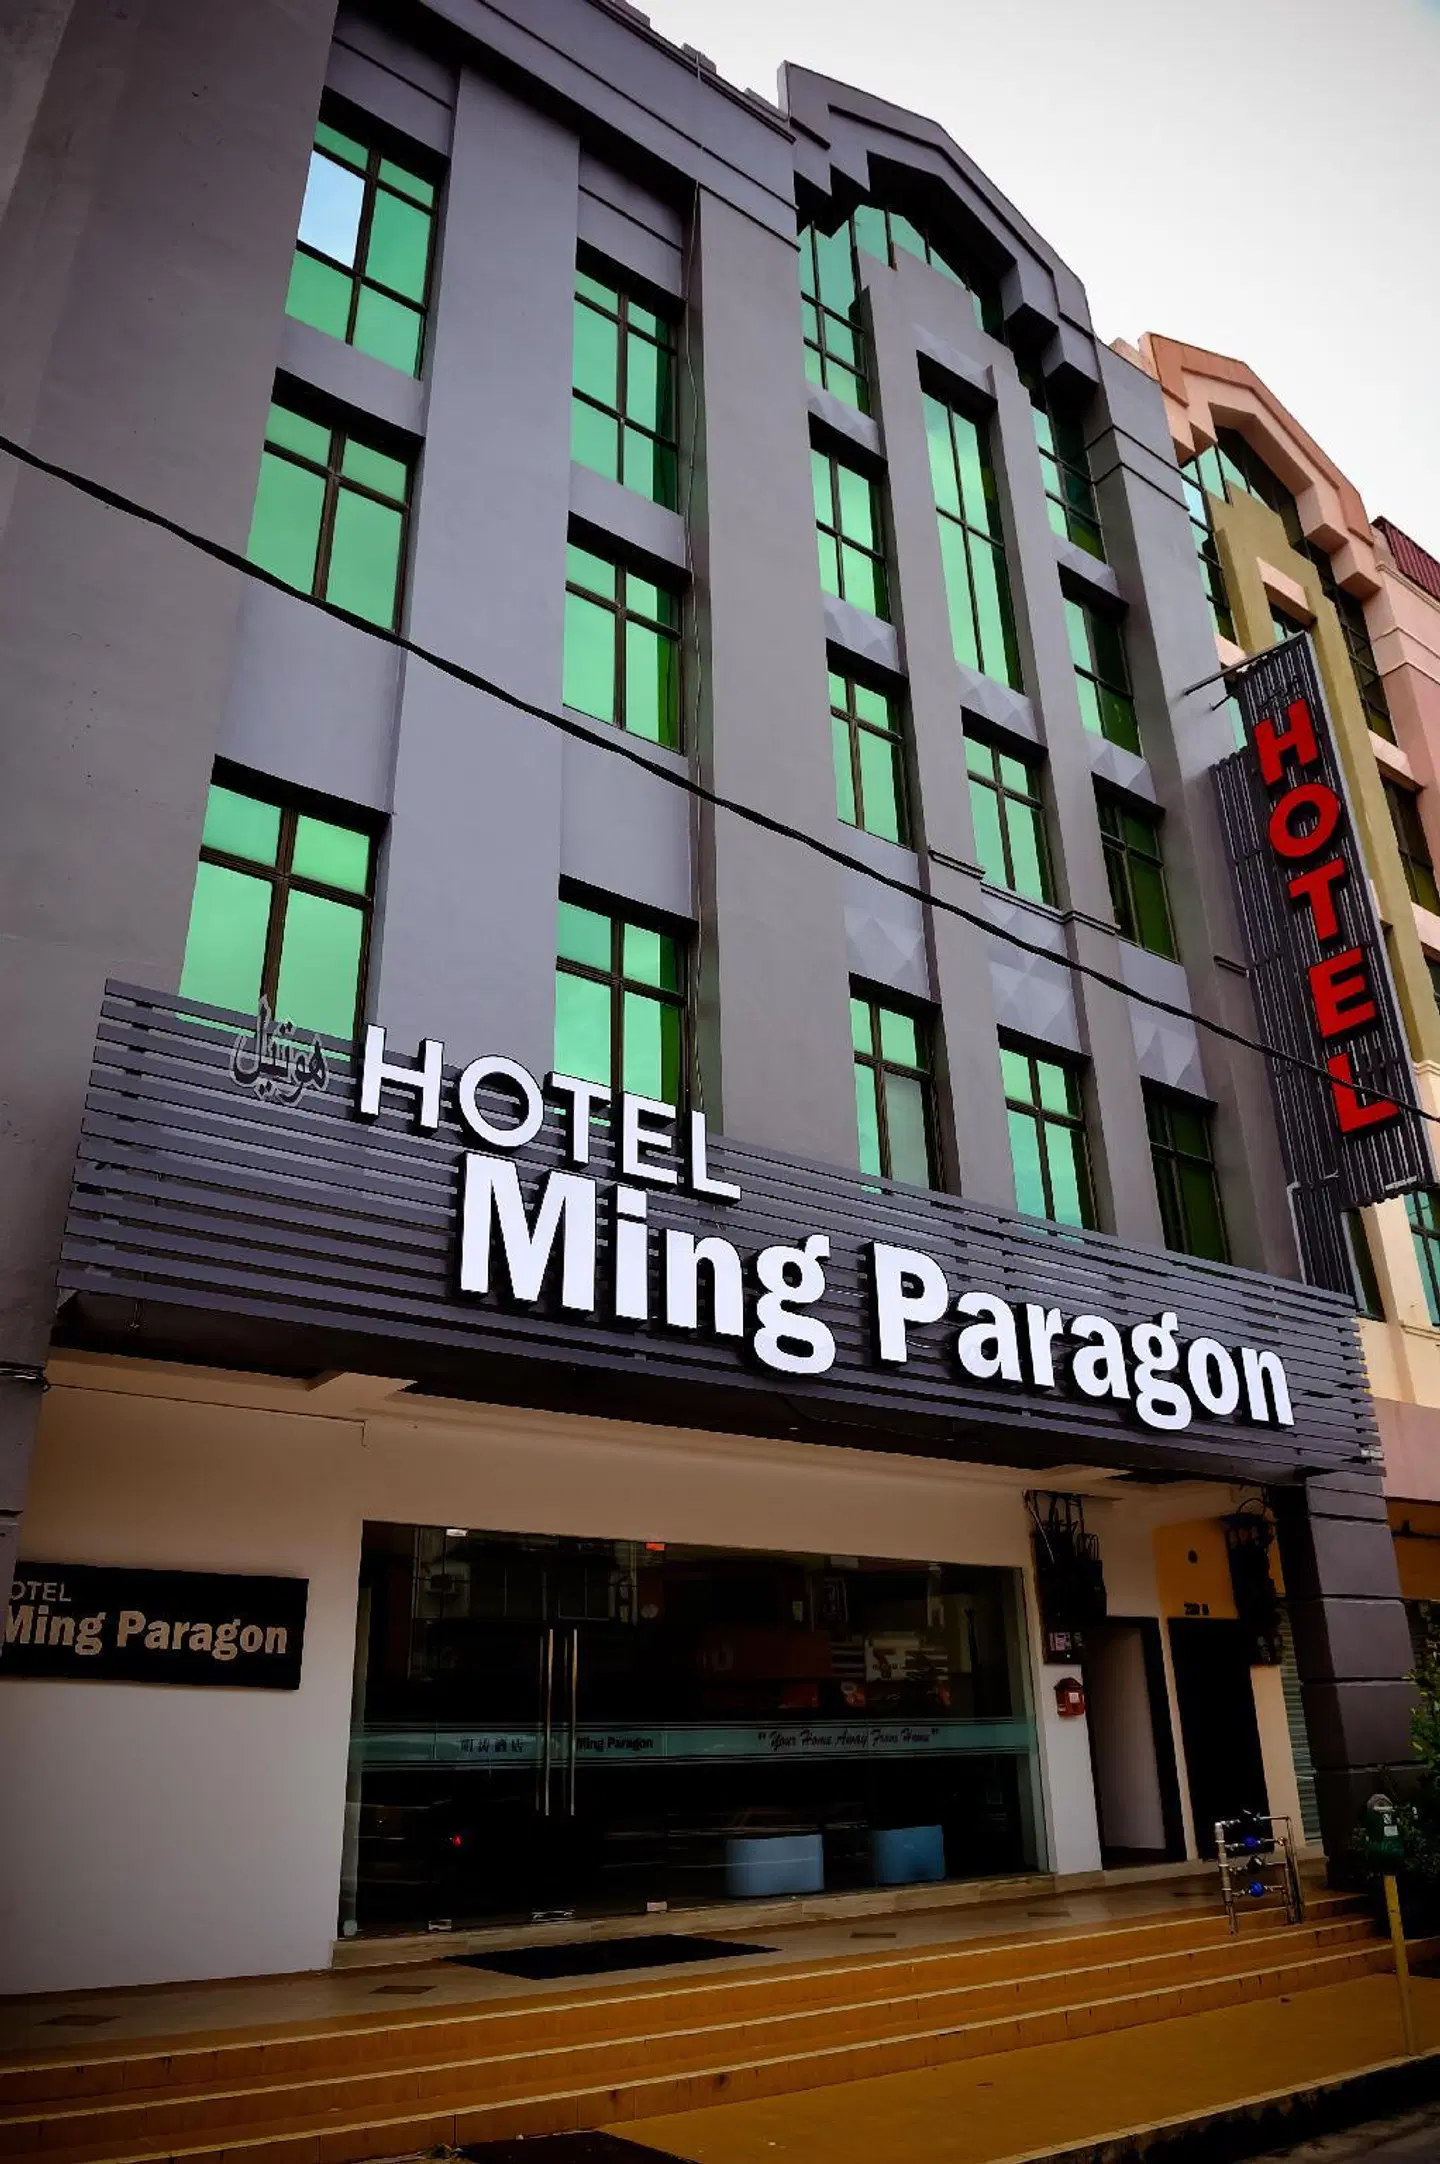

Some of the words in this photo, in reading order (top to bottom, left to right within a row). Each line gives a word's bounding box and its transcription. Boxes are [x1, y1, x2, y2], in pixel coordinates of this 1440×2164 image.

[1253, 698, 1399, 1133] HOTEL
[359, 1025, 742, 1203] HOTEL
[458, 1152, 837, 1374] Ming
[872, 1241, 1295, 1431] Paragon
[10, 1580, 72, 1602] OTEL
[4, 1604, 107, 1656] Ming
[117, 1610, 287, 1661] Paragon
[576, 1736, 605, 1752] Ming
[607, 1736, 654, 1751] Paragon
[834, 1727, 868, 1748] Away
